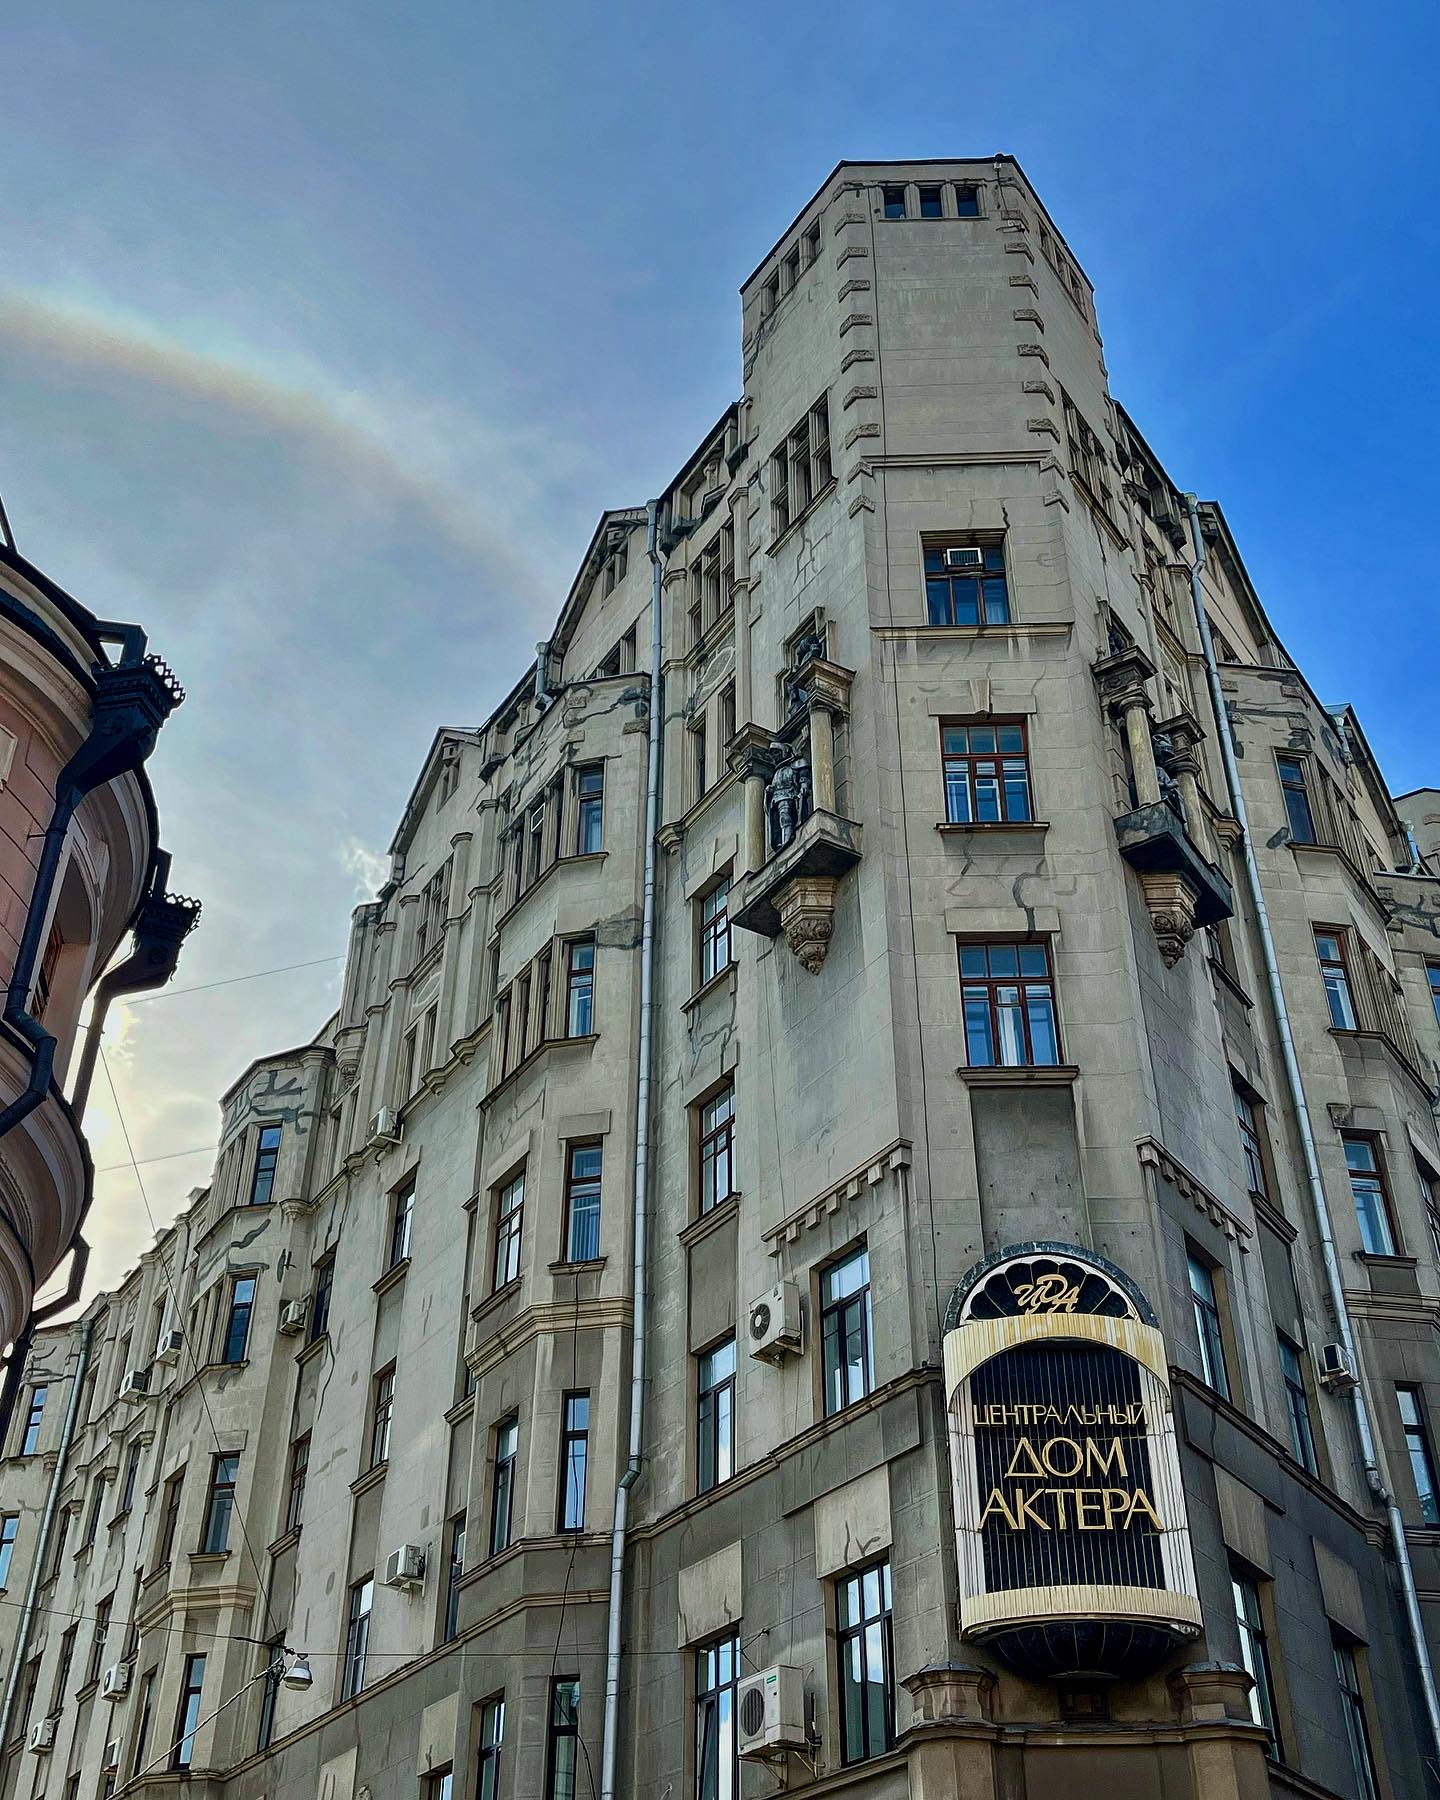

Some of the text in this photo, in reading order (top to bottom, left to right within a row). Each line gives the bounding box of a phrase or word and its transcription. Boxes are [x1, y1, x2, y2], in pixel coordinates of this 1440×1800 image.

[972, 1402, 1149, 1426] ЦЕНТРАЛЬНЫЙ
[1004, 1436, 1128, 1479] ДОМ
[978, 1488, 1165, 1531] АКТЕРА
